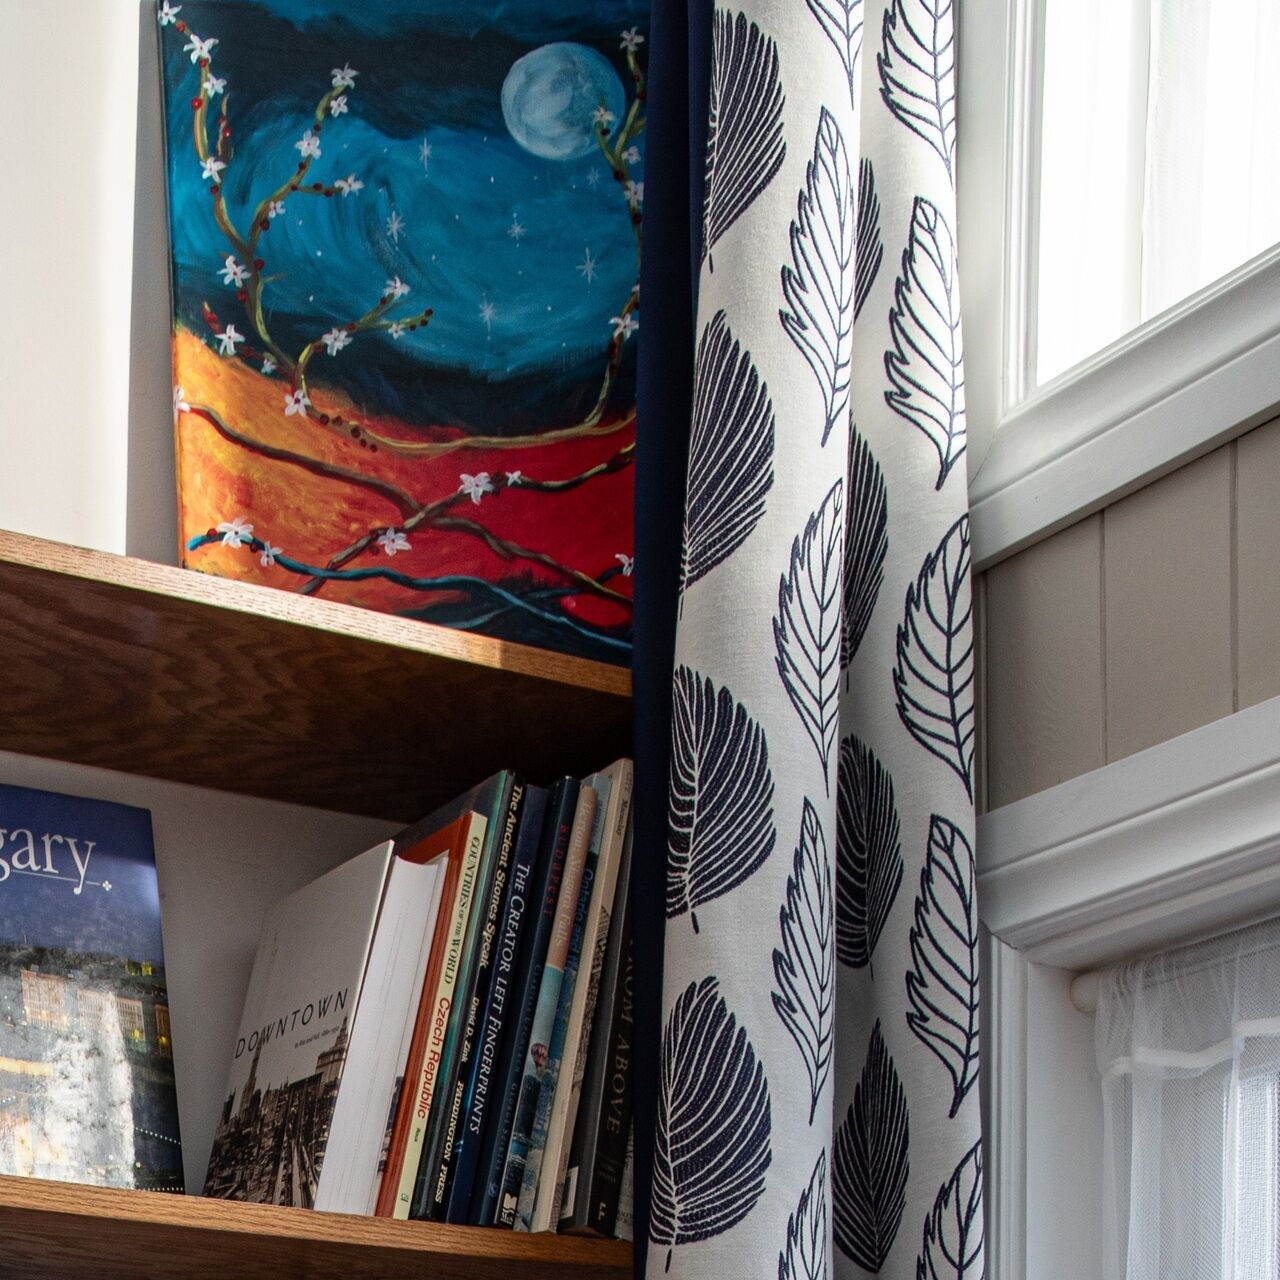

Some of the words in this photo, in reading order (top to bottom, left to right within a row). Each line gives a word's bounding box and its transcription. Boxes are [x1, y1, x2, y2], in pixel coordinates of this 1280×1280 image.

[458, 836, 481, 910] COUNTRIES
[515, 864, 530, 892] THE
[445, 937, 461, 985] WORLD
[498, 895, 526, 971] CREATOR
[235, 988, 349, 1060] DOWNTOWN
[431, 997, 450, 1049] Czech
[490, 977, 509, 1018] LEFT
[418, 1051, 439, 1119] Republic
[470, 1018, 504, 1135] FINGERPRINTS
